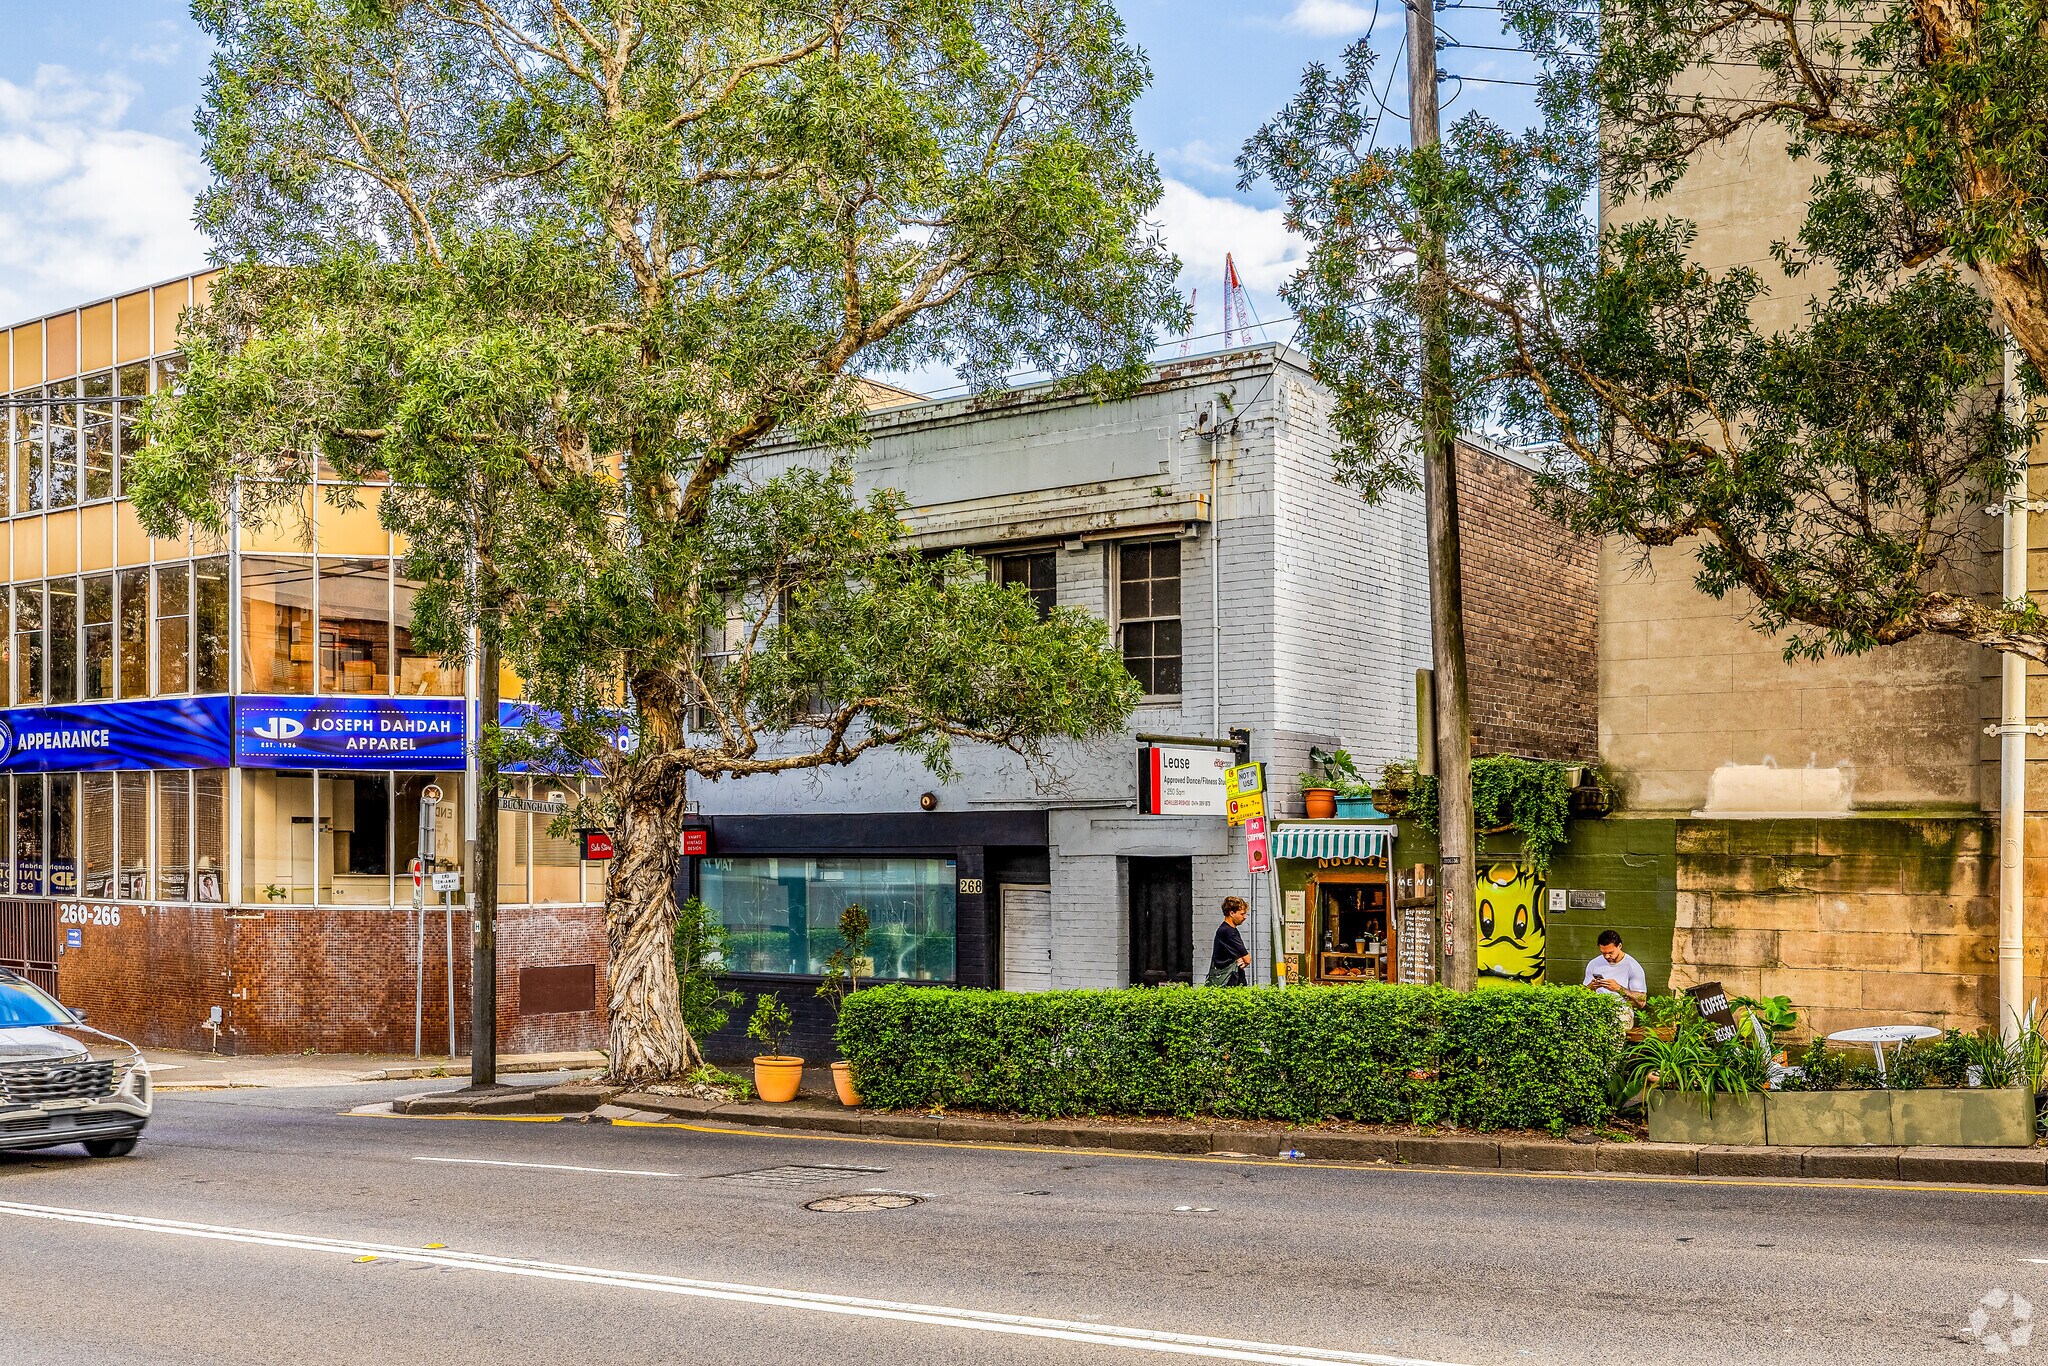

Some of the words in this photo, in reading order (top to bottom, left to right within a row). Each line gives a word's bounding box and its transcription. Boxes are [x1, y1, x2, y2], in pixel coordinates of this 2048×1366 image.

[253, 717, 304, 740] JD
[312, 718, 374, 732] JOSEPH
[380, 720, 450, 733] DAHDAH
[17, 729, 110, 750] APPEARANCE
[346, 738, 416, 750] APPAREL
[1163, 752, 1190, 769] Lease
[1164, 776, 1185, 784] Approved
[1186, 776, 1217, 785] Dance/Fitness
[1239, 772, 1249, 780] NOT
[1242, 779, 1253, 787] USE
[503, 800, 554, 813] BUCKINGHAM
[1230, 801, 1238, 814] C
[1251, 821, 1259, 830] NO
[961, 880, 982, 892] 268
[1398, 878, 1433, 886] MENU
[60, 904, 120, 926] 260-266
[1700, 993, 1728, 1016] COFFEE
